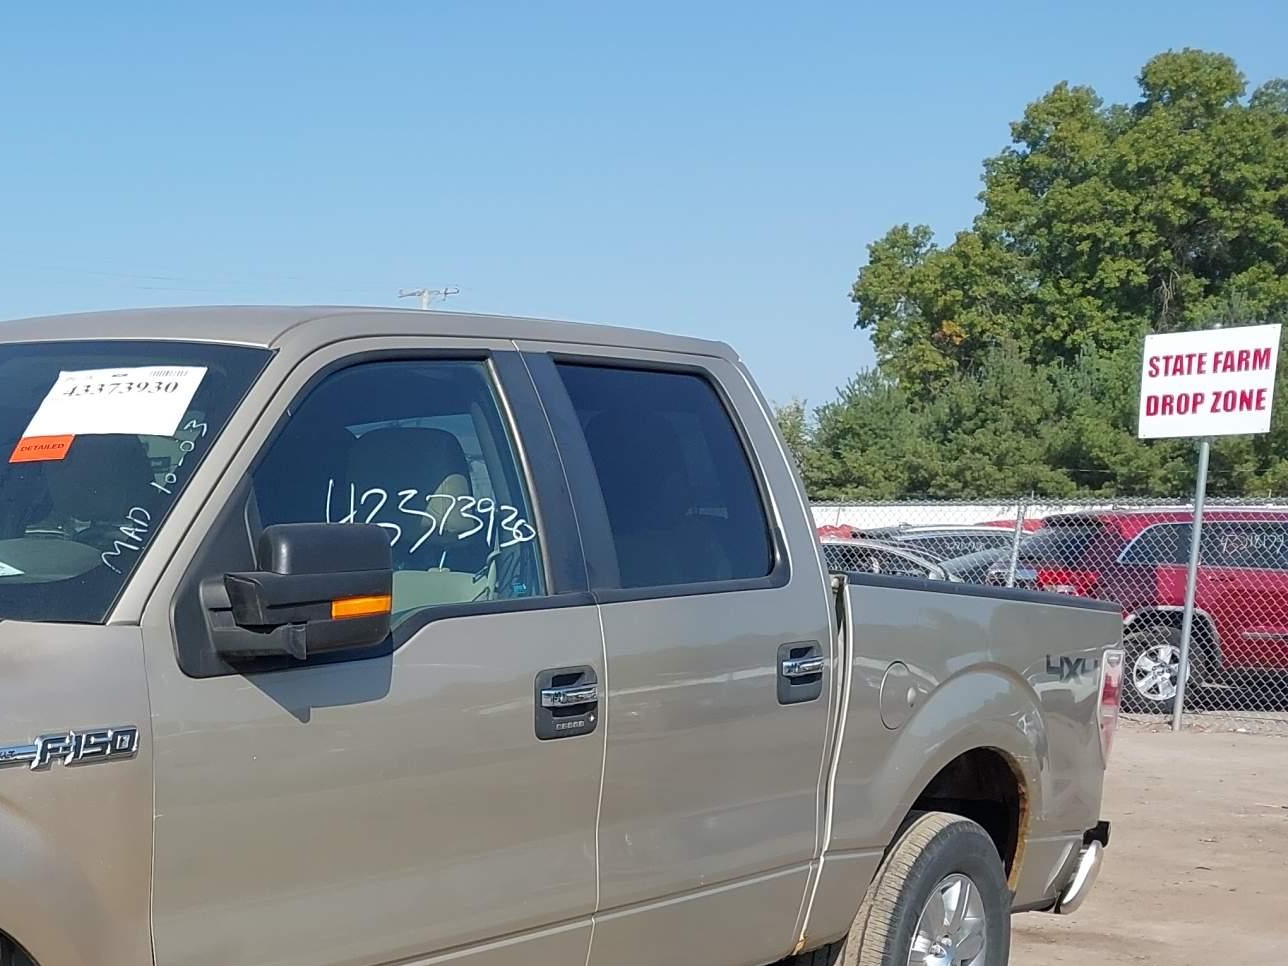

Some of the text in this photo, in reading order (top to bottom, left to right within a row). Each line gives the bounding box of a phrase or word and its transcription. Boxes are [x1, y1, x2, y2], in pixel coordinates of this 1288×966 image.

[1147, 347, 1273, 379] STATE FARM
[63, 381, 180, 397] 43373930
[1145, 387, 1268, 417] DROP ZONE
[20, 442, 65, 452] DETAILED
[101, 419, 208, 574] MAD 10-03
